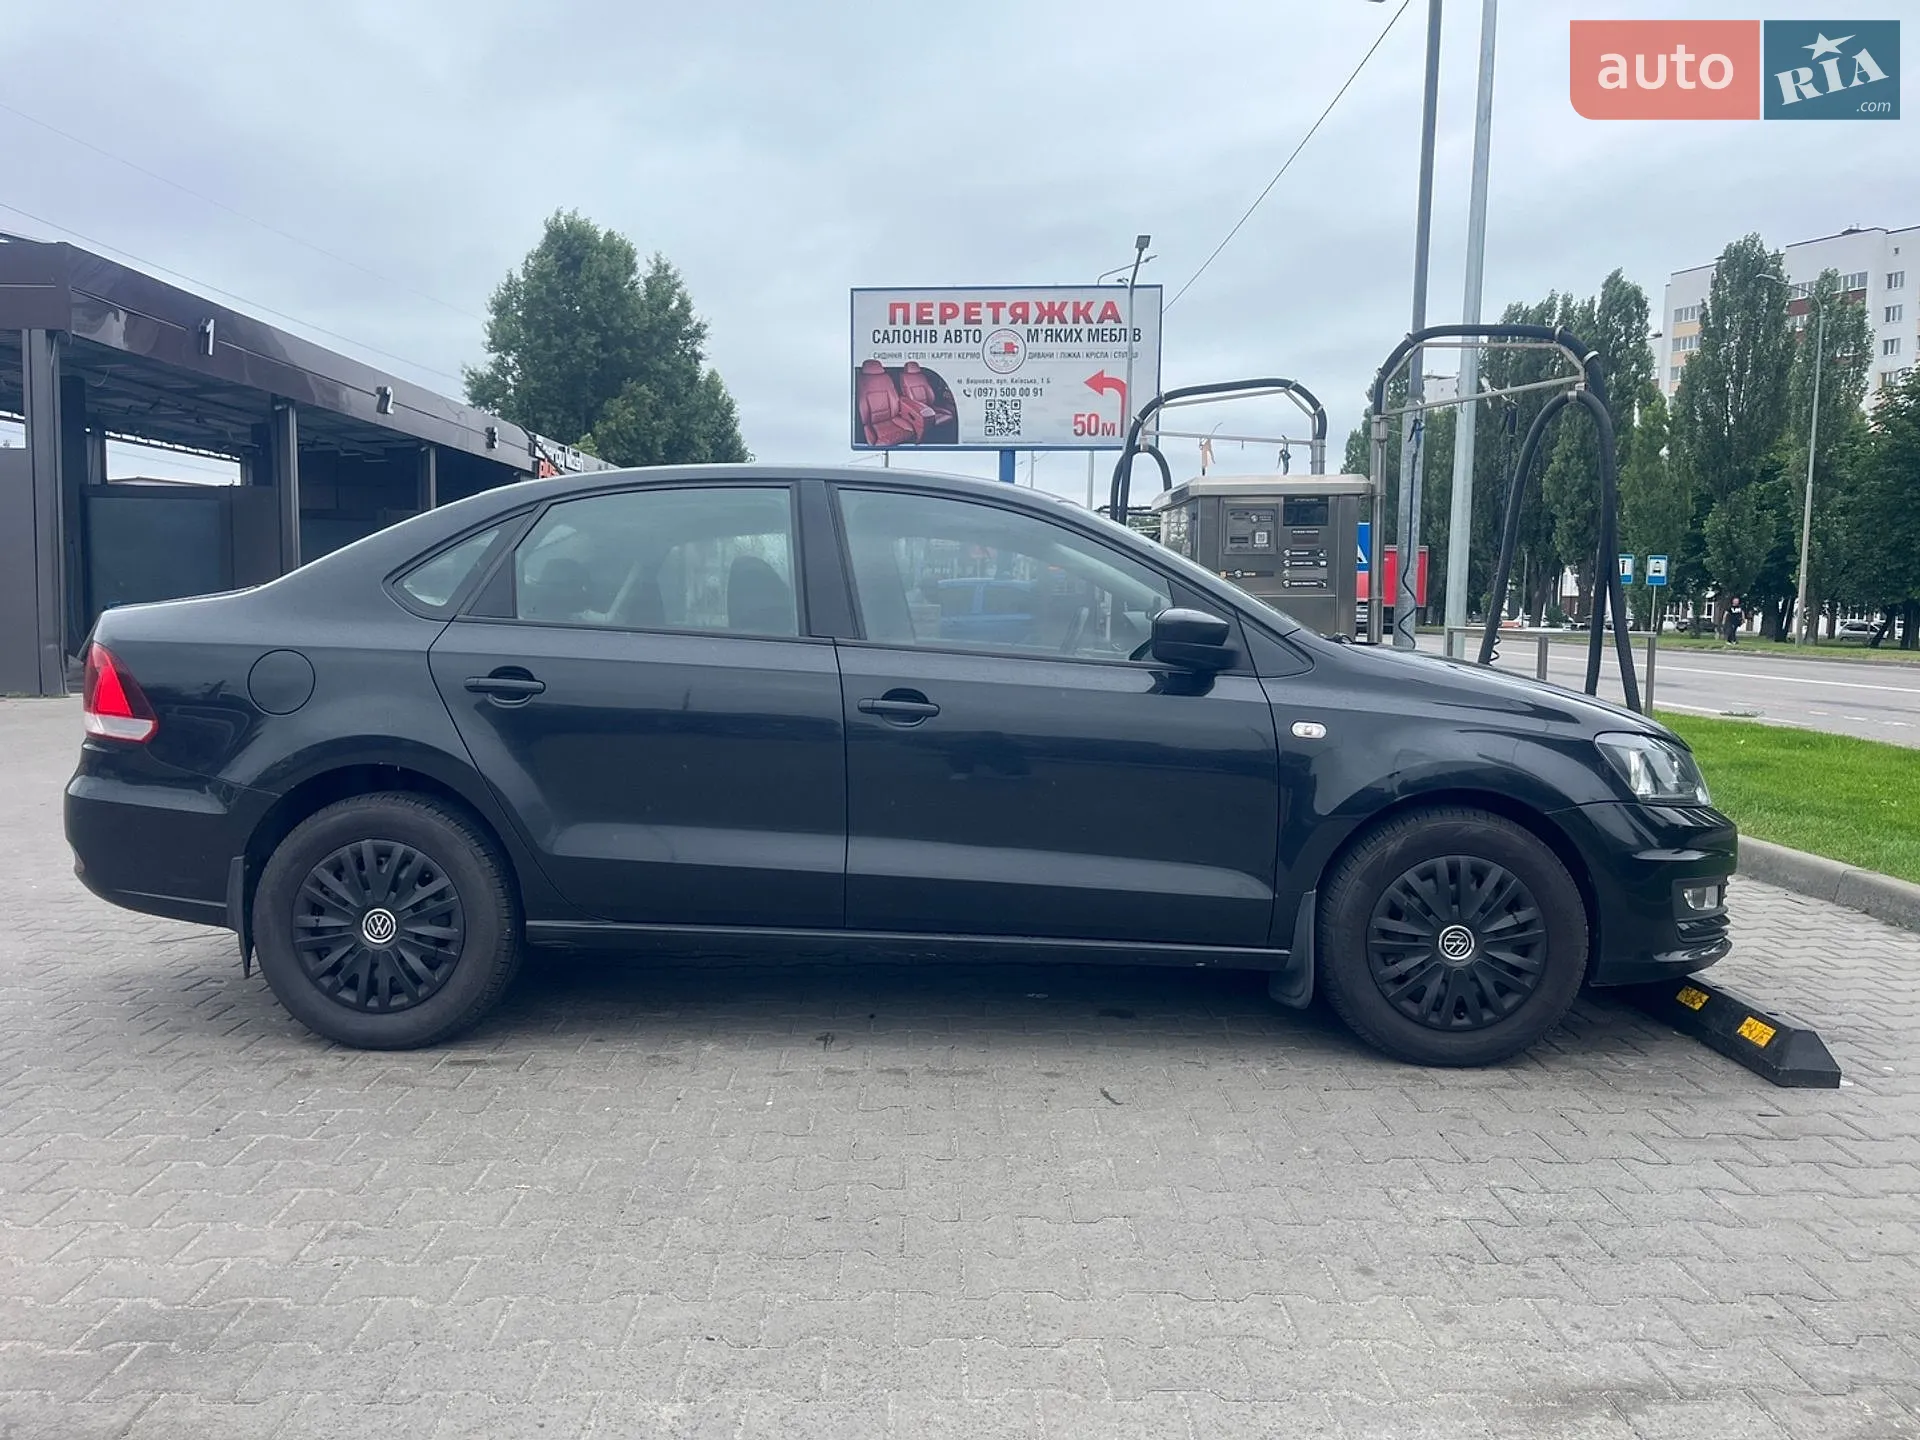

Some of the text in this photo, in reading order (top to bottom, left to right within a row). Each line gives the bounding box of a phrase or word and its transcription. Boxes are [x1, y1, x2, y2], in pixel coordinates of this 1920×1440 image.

[888, 301, 1123, 325] ПЕРЕТЯЖКА
[203, 318, 215, 356] 1
[872, 329, 938, 344] САЛОНІВ
[943, 329, 983, 344] АВТО
[1087, 328, 1142, 343] МЕБЛВ
[973, 387, 1043, 399] (097) 500 00 91
